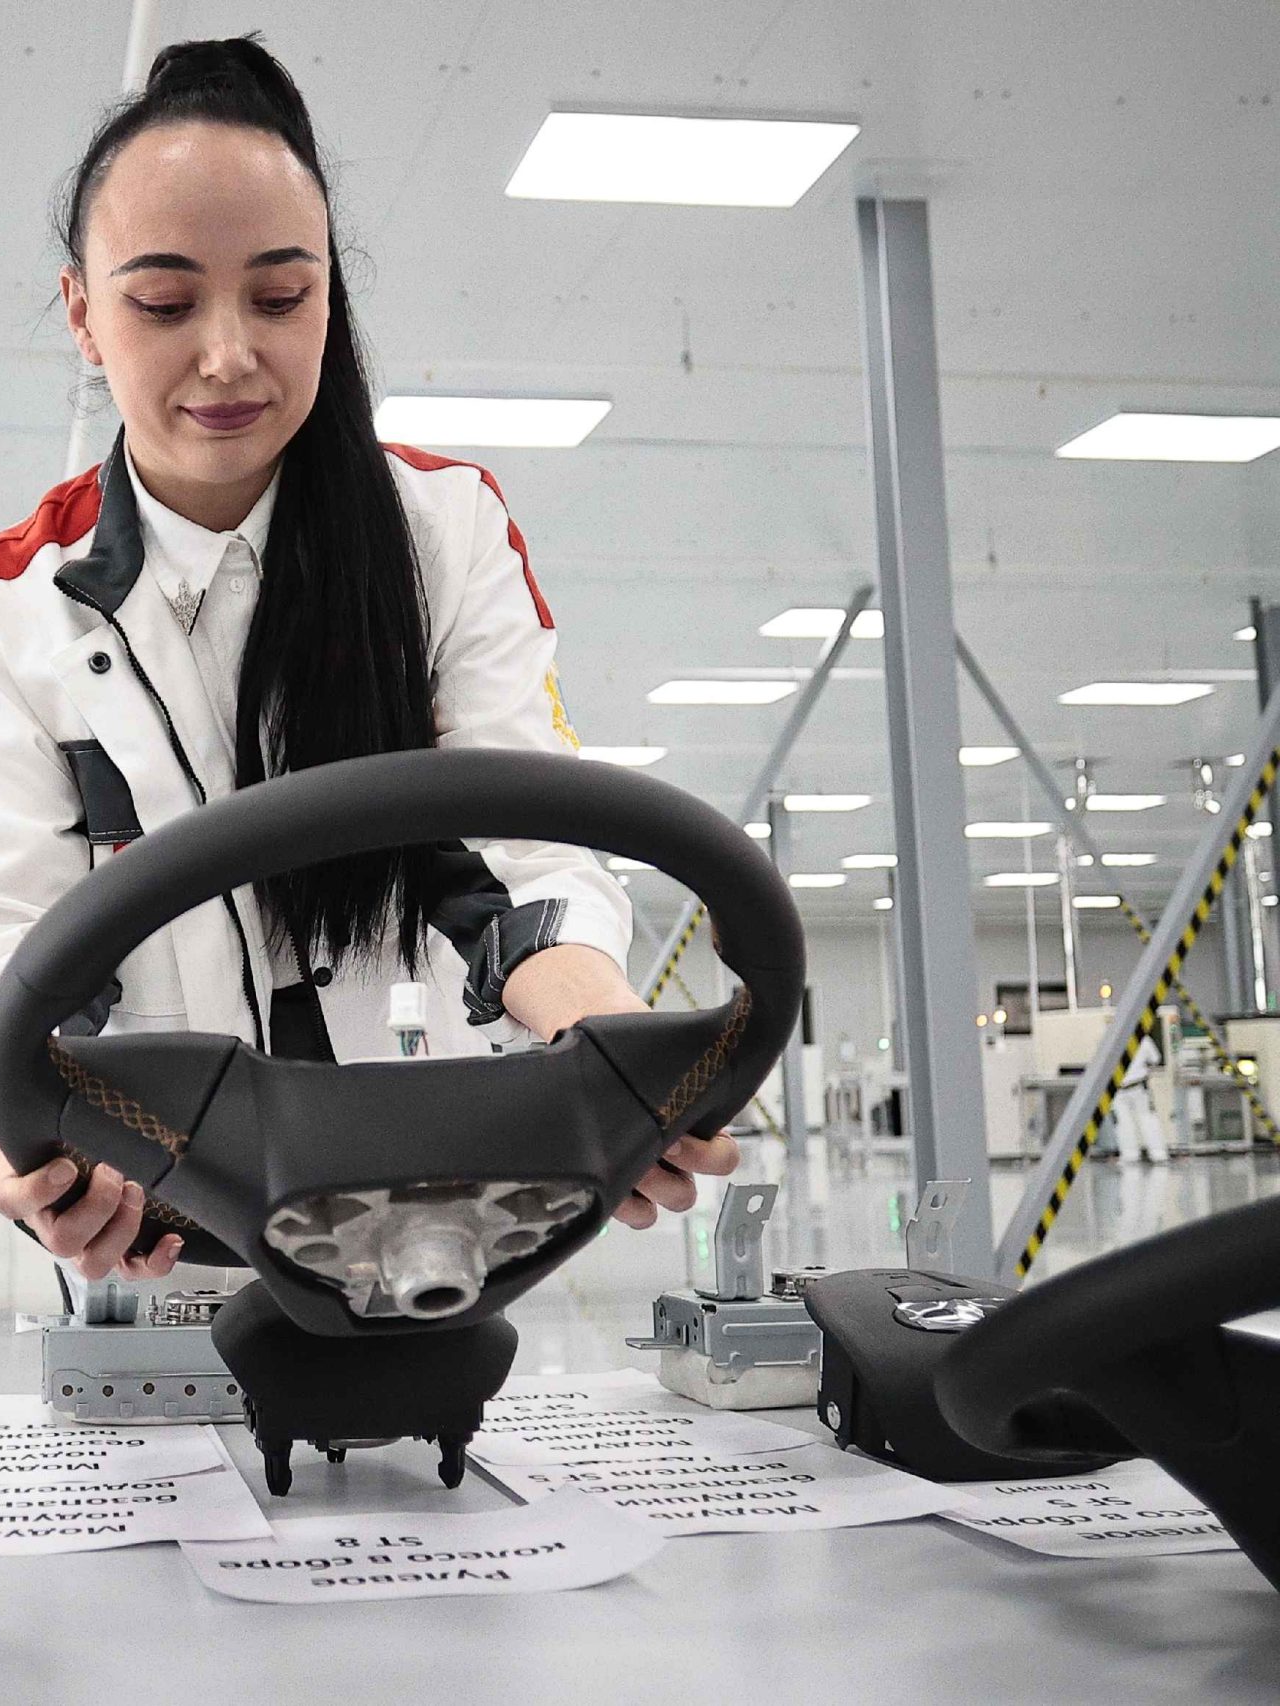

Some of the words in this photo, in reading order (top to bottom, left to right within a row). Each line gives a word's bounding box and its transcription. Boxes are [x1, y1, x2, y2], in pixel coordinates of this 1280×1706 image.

[487, 1392, 589, 1402] (Атлан
[521, 1429, 677, 1443] подушки
[549, 1440, 693, 1451] Модуль
[610, 1463, 788, 1477] водителя
[527, 1474, 551, 1482] 5
[562, 1473, 603, 1482] SF
[614, 1491, 798, 1507] подушки
[1047, 1498, 1078, 1508] 5
[1085, 1497, 1132, 1507] SF
[648, 1505, 821, 1520] Модуль
[1100, 1513, 1130, 1521] в
[968, 1515, 1093, 1528] сборе
[1075, 1524, 1225, 1541] улевое
[335, 1538, 361, 1548] 8
[376, 1537, 423, 1548] ST
[407, 1543, 566, 1562] колесо
[219, 1557, 354, 1571] сборе
[368, 1555, 392, 1564] в
[311, 1570, 512, 1588] Рулевое
